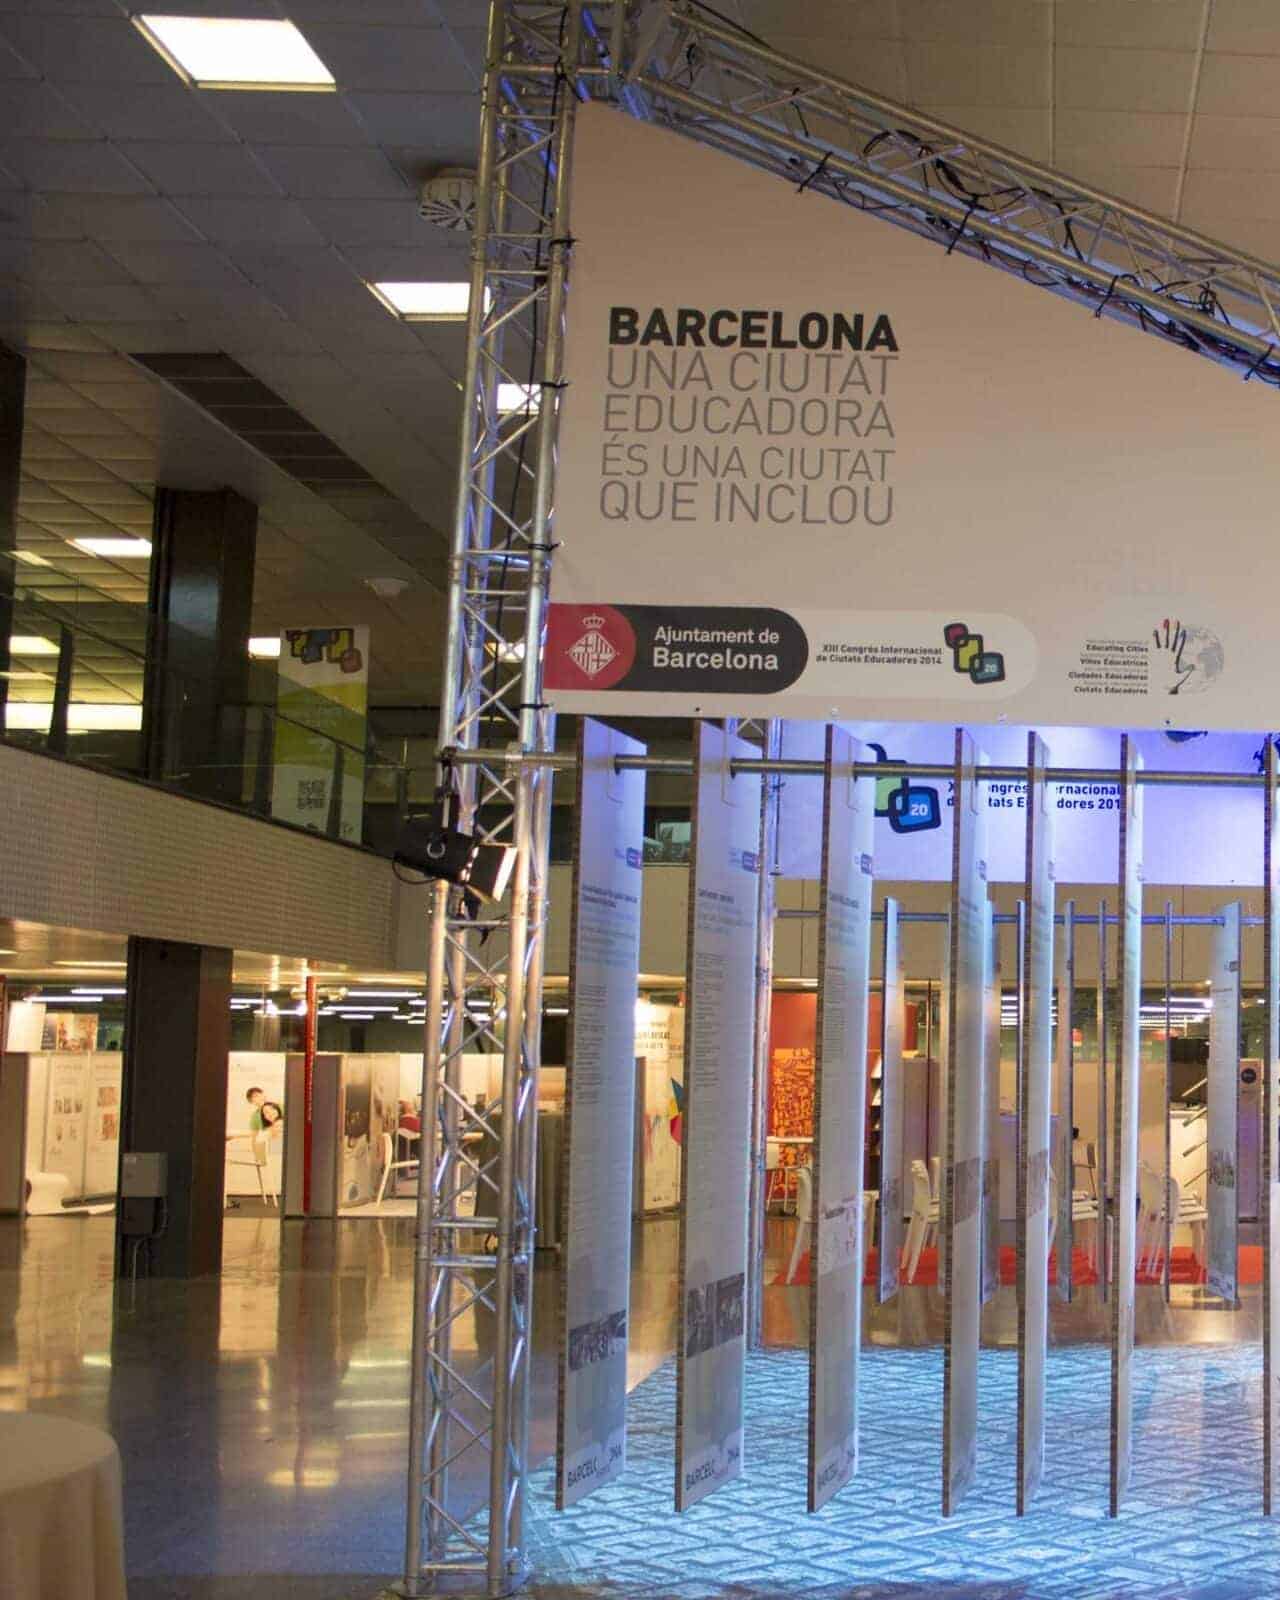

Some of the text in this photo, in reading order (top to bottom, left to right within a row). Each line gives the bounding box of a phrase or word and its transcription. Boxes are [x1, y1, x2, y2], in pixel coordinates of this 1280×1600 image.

[608, 307, 899, 351] BARCELONA
[607, 348, 899, 395] UNA CIUTAT
[603, 395, 895, 438] EDUCADORA
[601, 432, 896, 481] ÉS UNA CIUTAT
[600, 480, 893, 526] QUE INCLOU
[655, 626, 779, 646] Ajuntament de
[880, 645, 943, 655] Internacional
[653, 647, 779, 670] Barcelona
[829, 654, 862, 663] Ciutats
[863, 655, 917, 665] Educadores
[919, 656, 943, 665] 2014
[909, 803, 928, 817] 20
